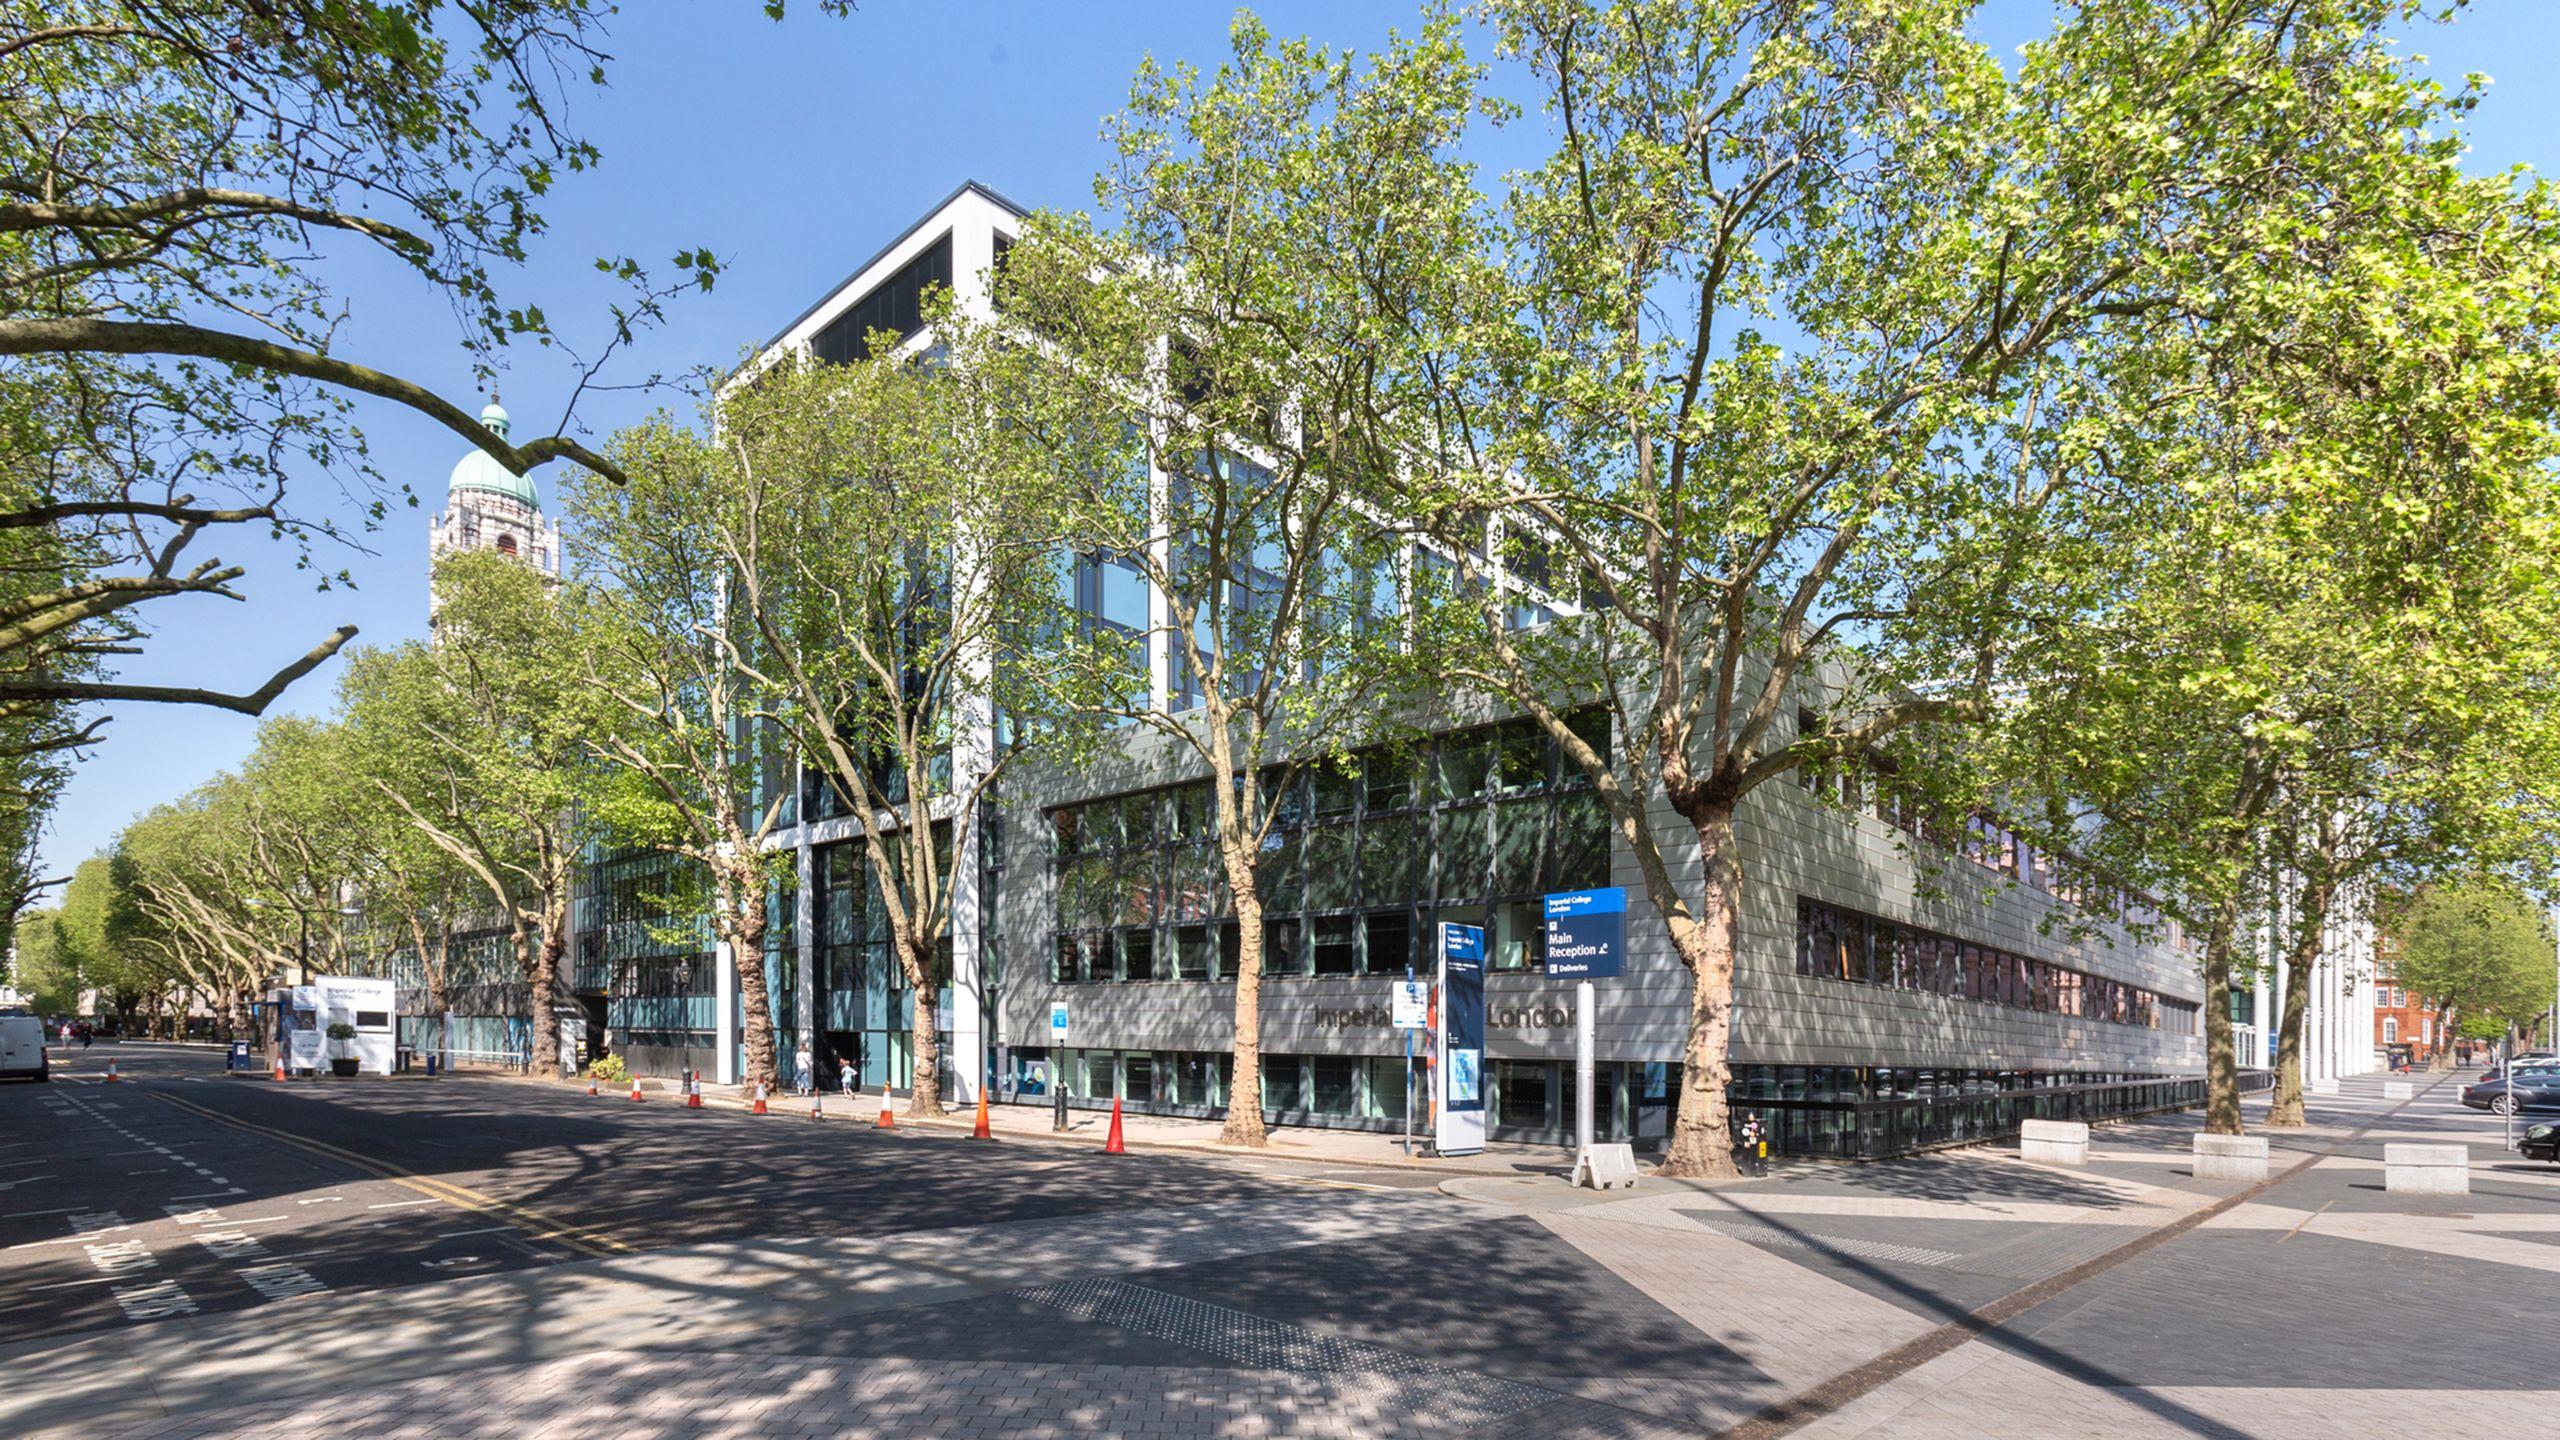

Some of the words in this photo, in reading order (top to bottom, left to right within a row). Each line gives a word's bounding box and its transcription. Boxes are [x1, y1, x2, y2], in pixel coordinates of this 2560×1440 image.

[1549, 898, 1571, 907] Imperial
[1571, 896, 1592, 904] College
[1549, 932, 1572, 945] Main
[1549, 944, 1596, 959] Reception
[1559, 963, 1589, 973] Deliveries
[1315, 1002, 1393, 1034] Imperial
